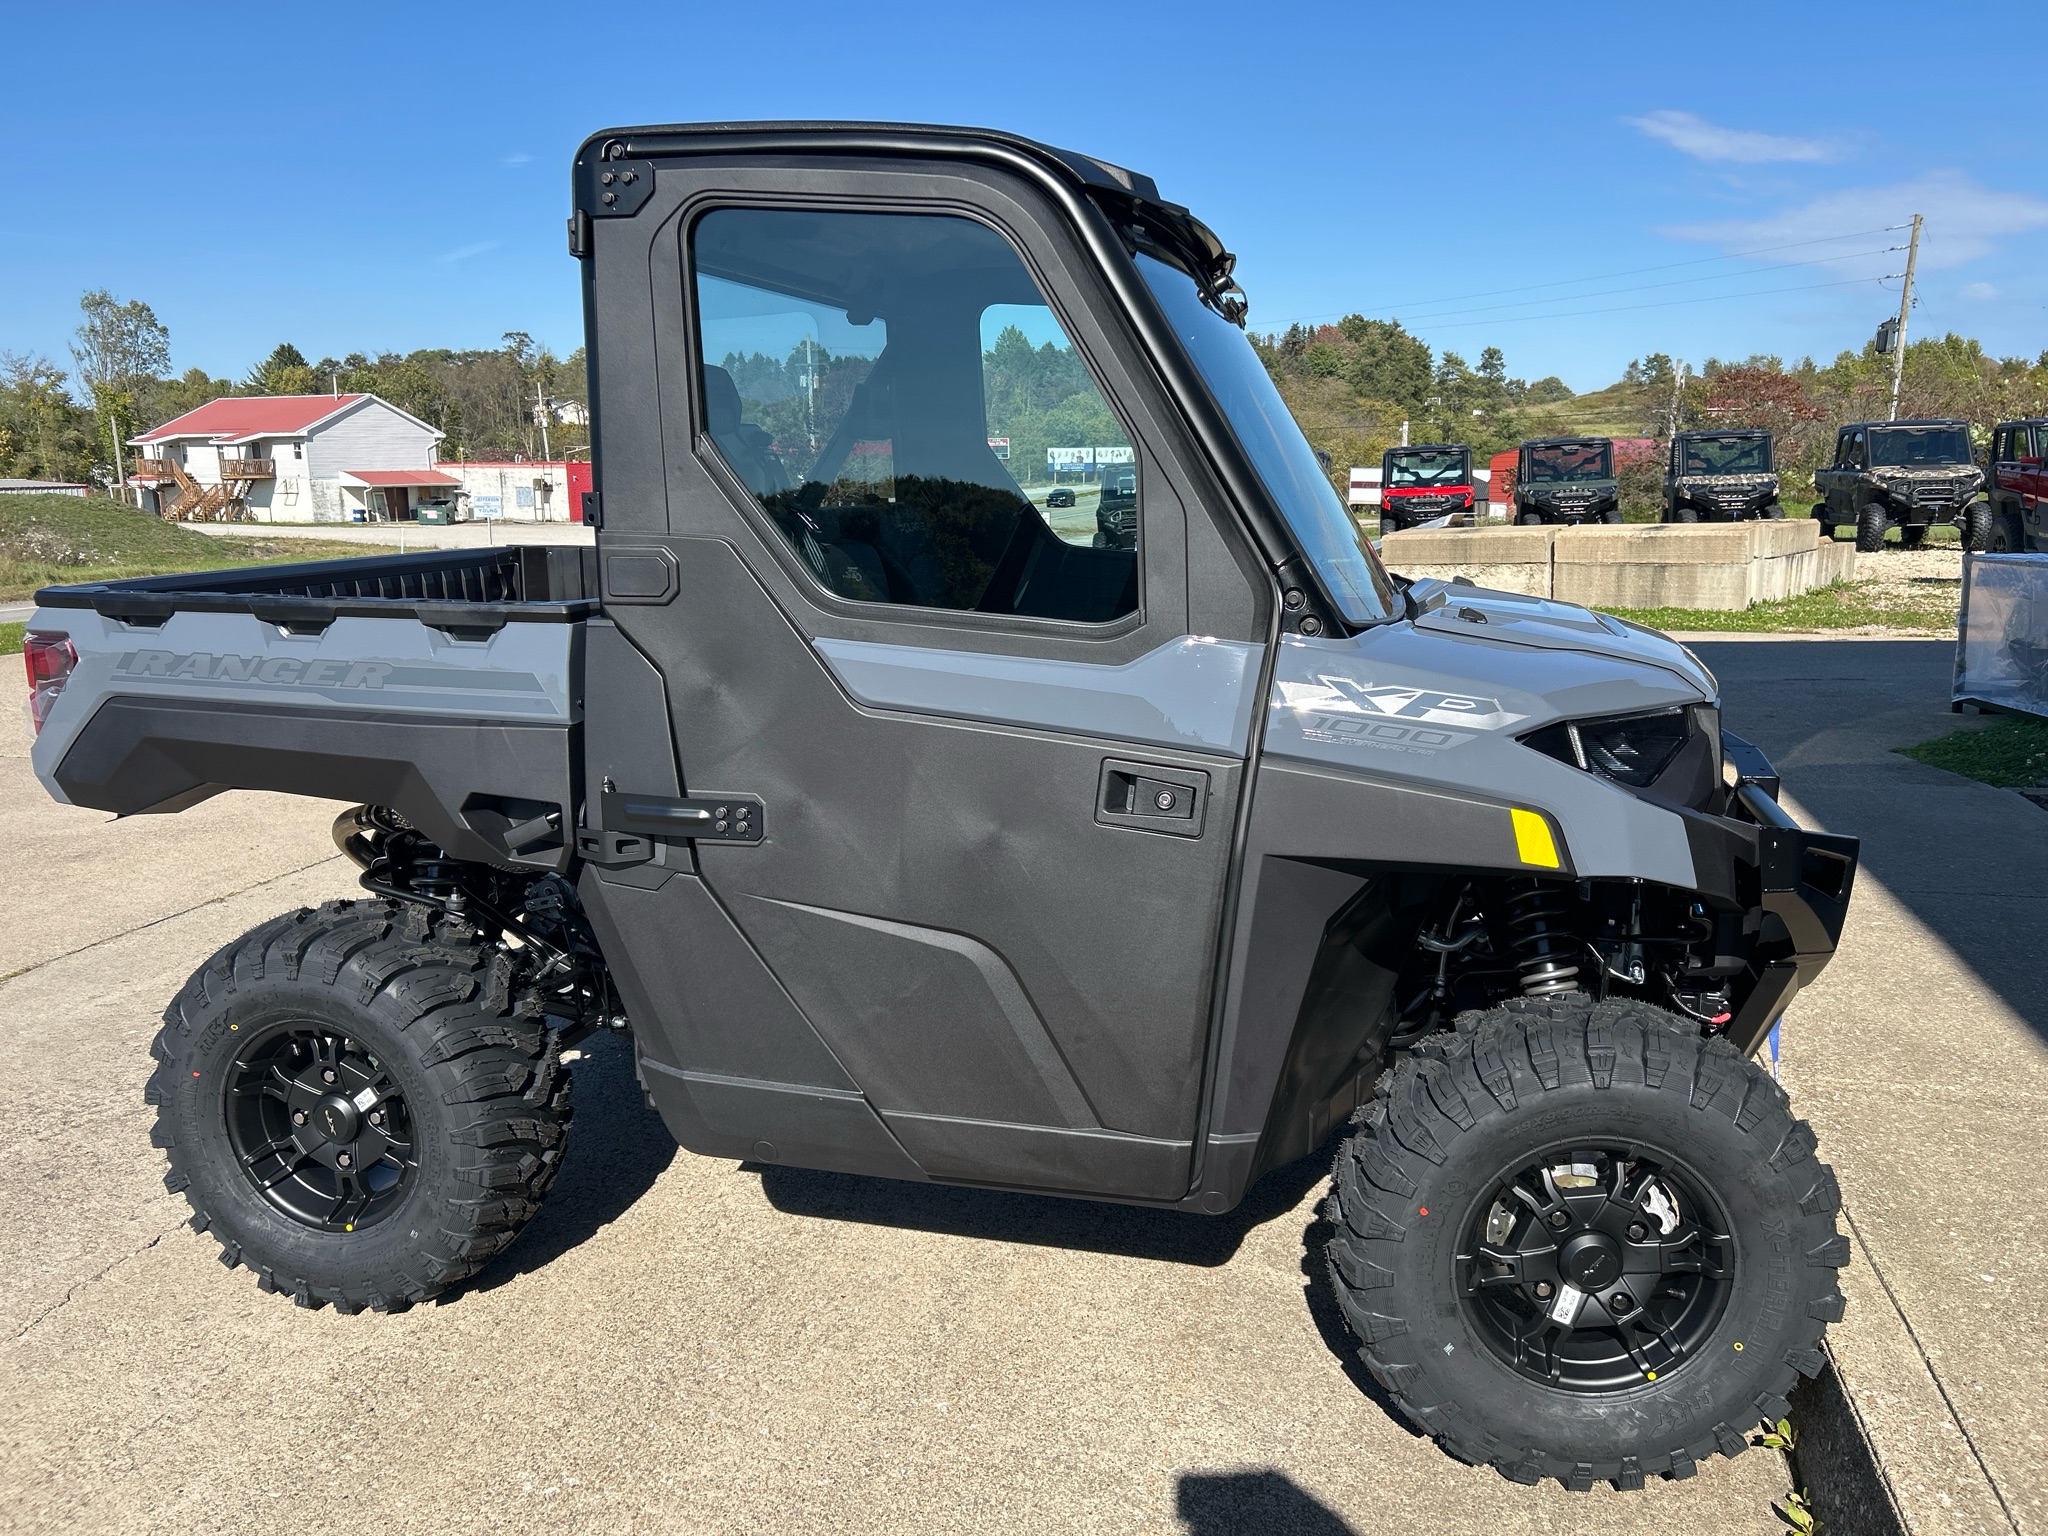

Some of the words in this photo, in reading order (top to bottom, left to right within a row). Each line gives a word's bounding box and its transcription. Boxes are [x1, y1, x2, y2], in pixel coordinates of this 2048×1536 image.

[126, 649, 395, 689] RANGER
[1318, 674, 1503, 718] XP
[1310, 716, 1453, 746] 1000
[1733, 1219, 1792, 1380] X-TERRAIN
